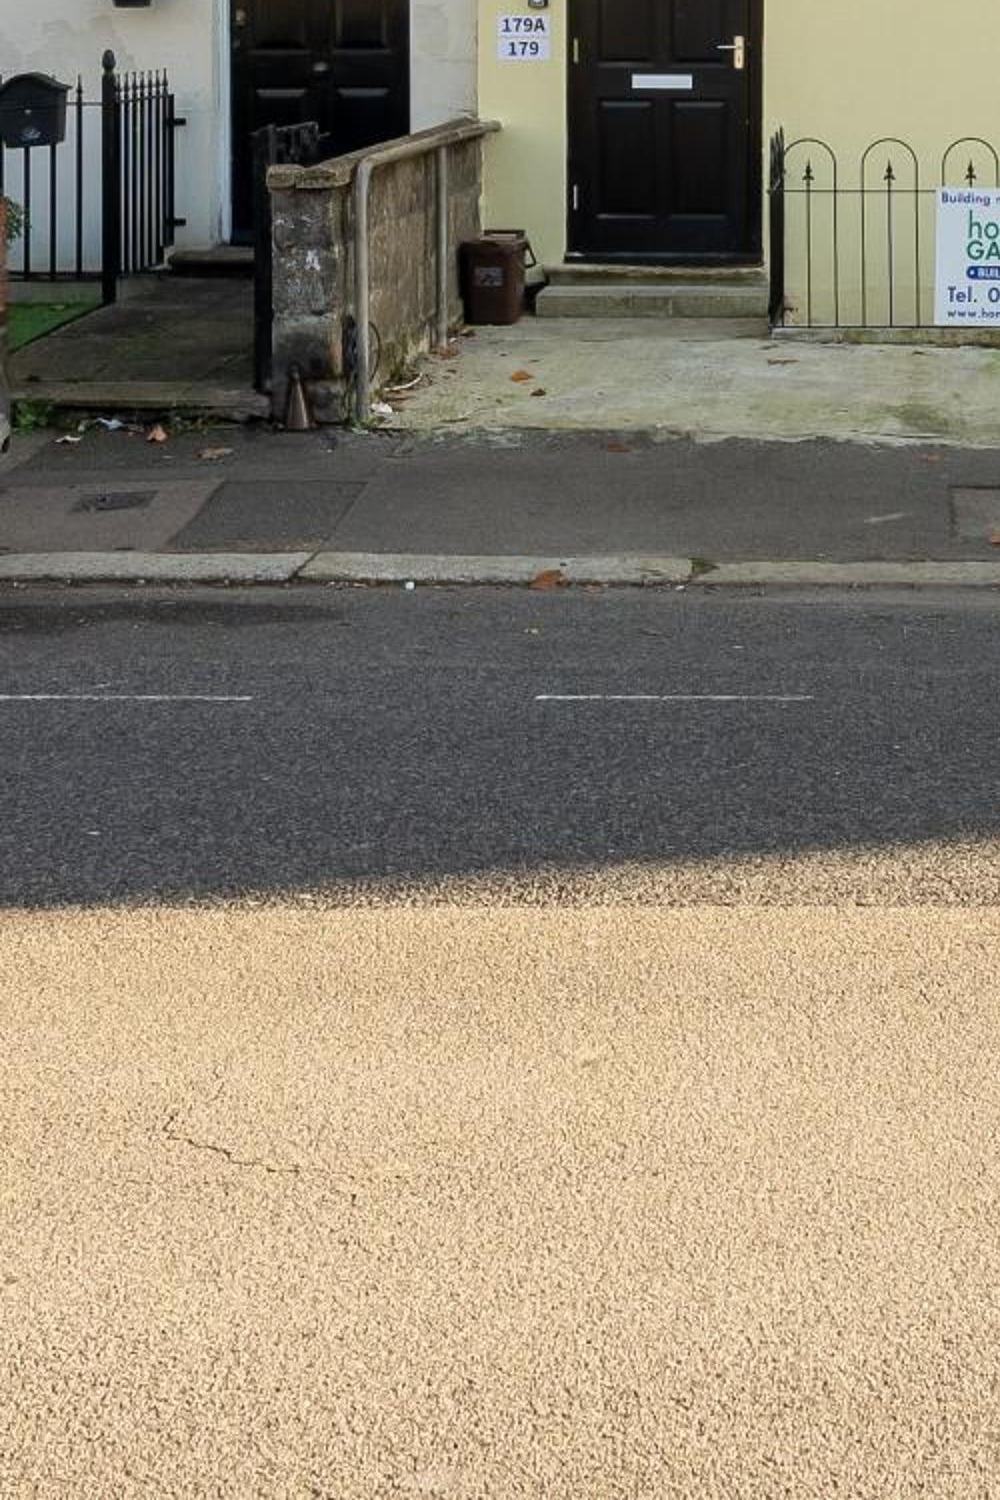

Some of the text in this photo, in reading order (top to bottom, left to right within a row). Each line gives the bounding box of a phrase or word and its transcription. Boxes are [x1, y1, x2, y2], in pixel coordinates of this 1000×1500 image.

[501, 17, 545, 33] 179A
[508, 41, 539, 56] 179
[941, 192, 991, 207] Building
[947, 286, 977, 303] Tel.
